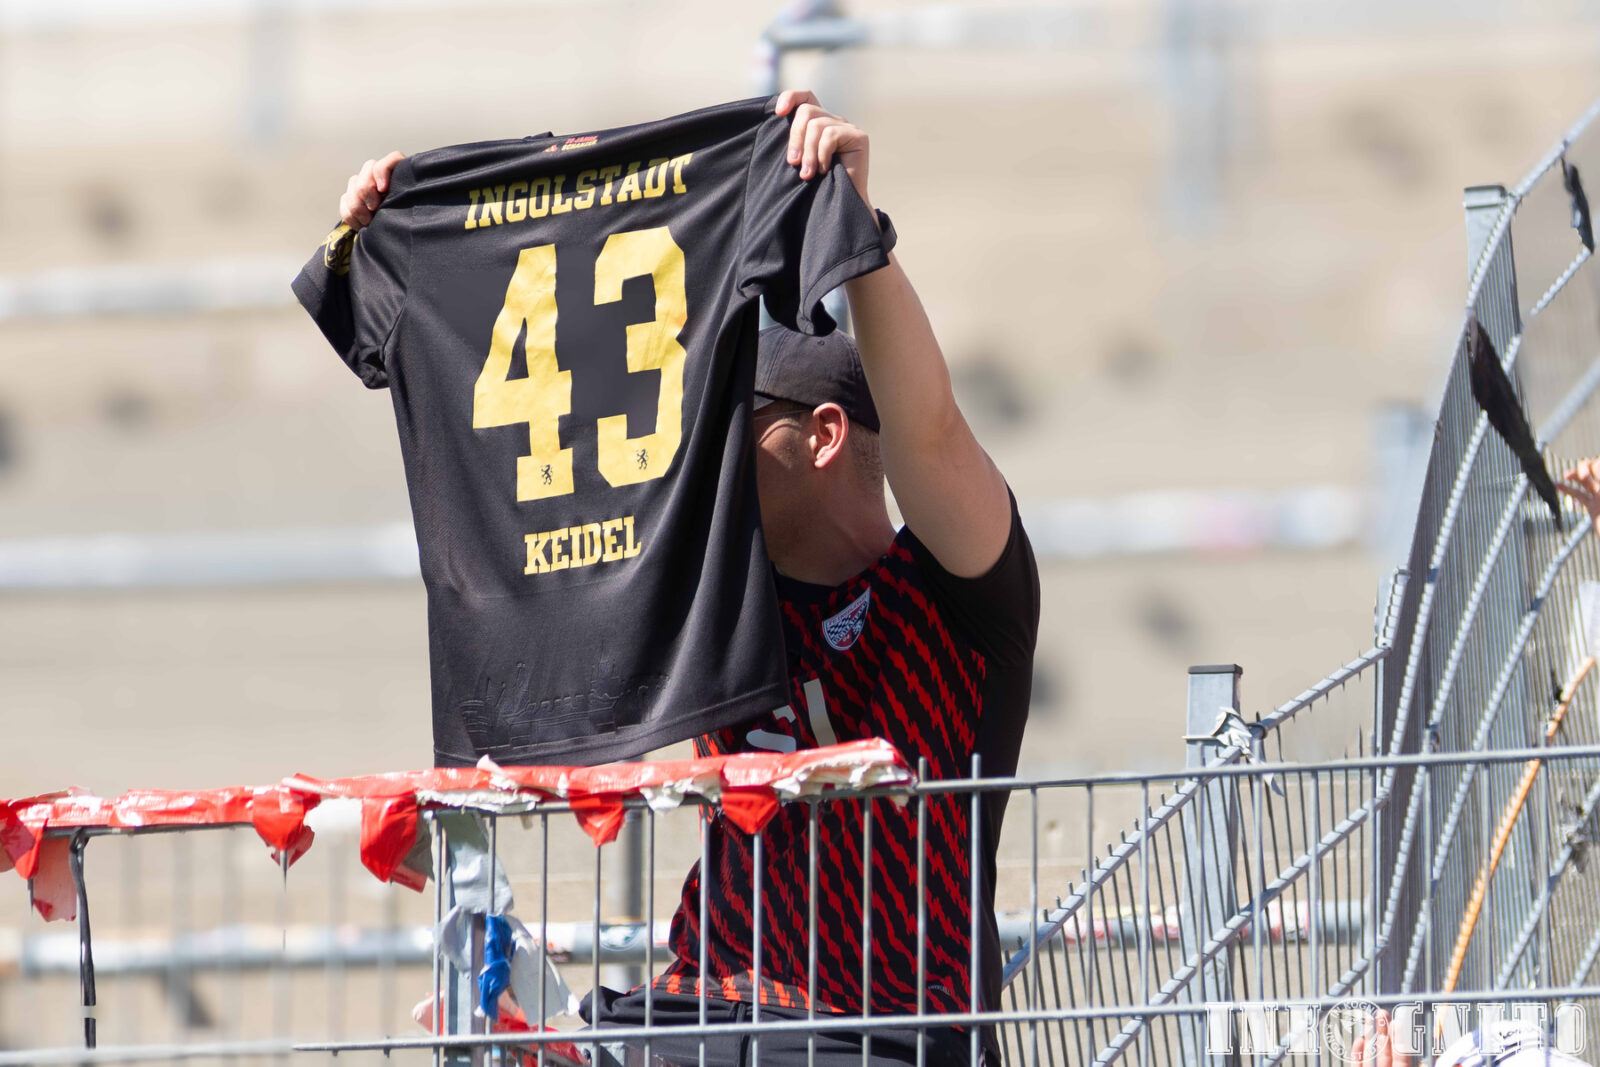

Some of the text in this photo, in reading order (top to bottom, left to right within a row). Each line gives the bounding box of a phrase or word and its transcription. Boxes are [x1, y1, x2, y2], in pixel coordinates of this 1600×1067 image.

[464, 153, 693, 230] INGOLSTADT
[472, 226, 687, 502] 43
[524, 516, 642, 576] KEIDEL
